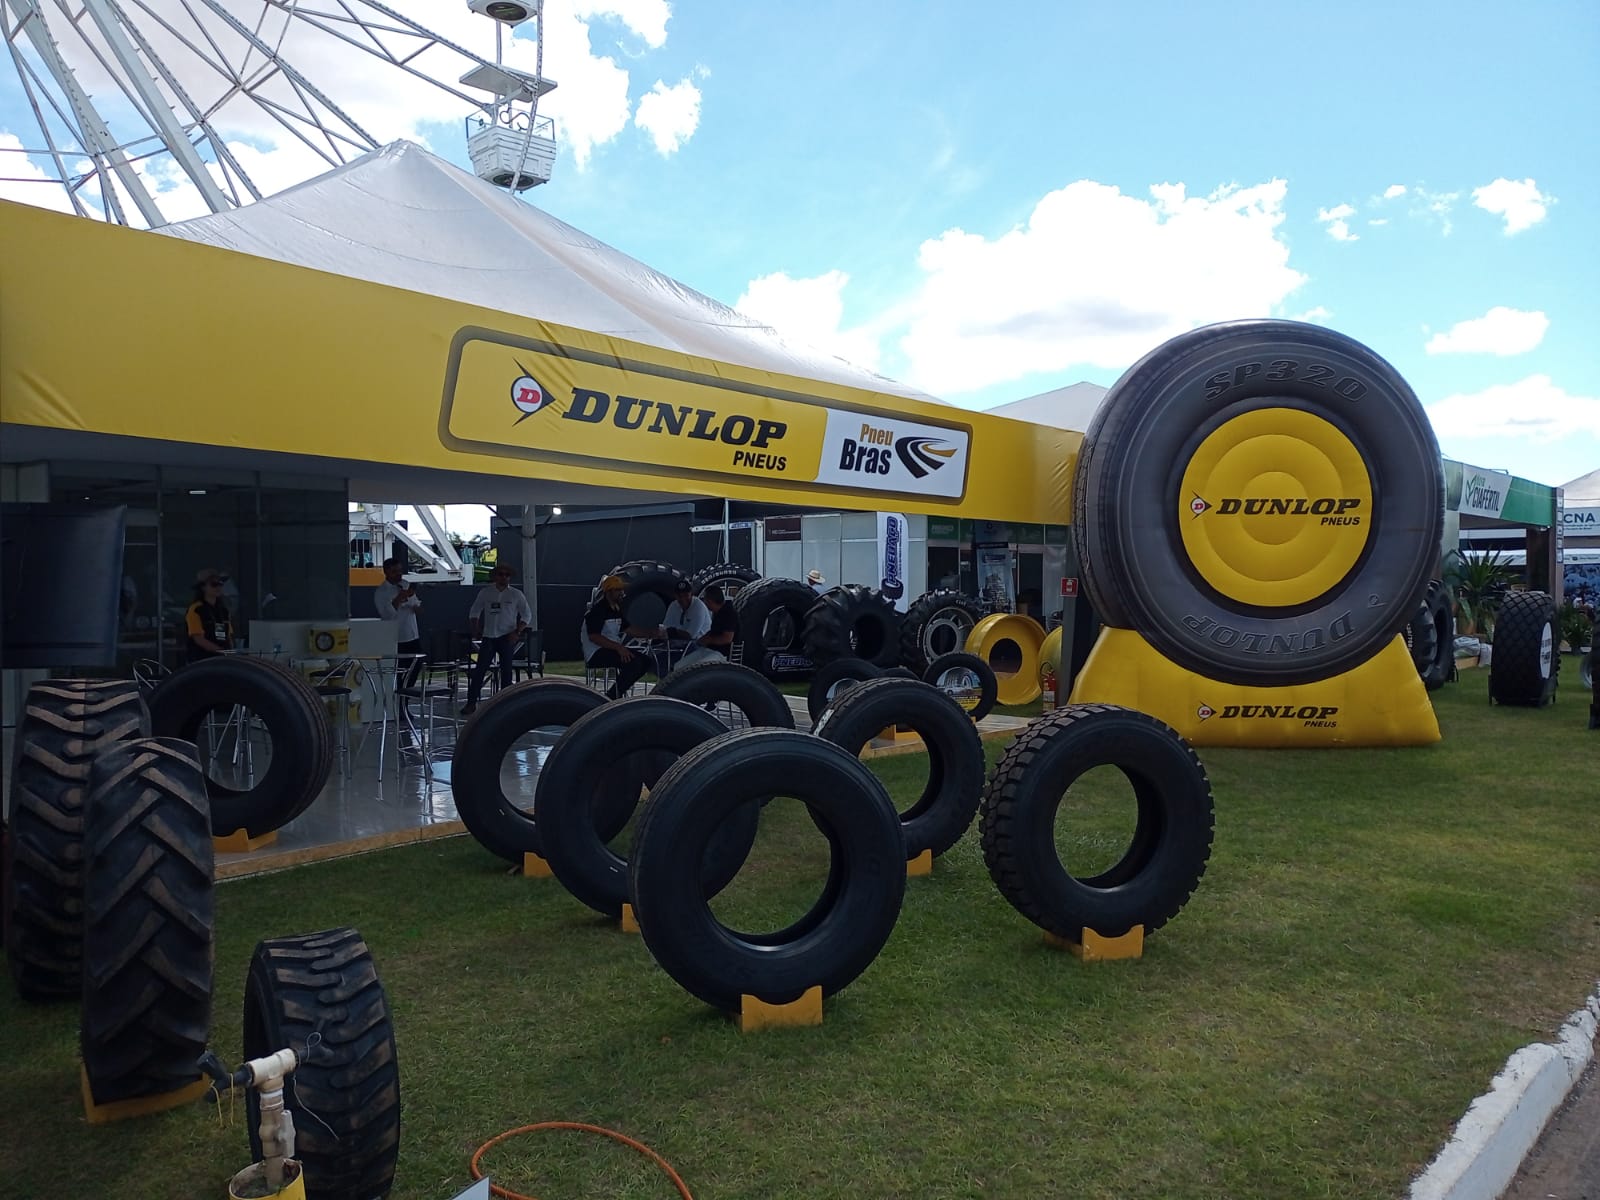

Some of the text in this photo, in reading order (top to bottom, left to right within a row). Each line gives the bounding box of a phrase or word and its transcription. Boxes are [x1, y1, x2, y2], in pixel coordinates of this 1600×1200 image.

[562, 386, 788, 449] DUNLOP
[859, 423, 894, 446] Pneu
[732, 450, 788, 472] PNEUS
[839, 438, 893, 476] Bras
[1216, 498, 1361, 515] DUNLOP
[1320, 516, 1361, 526] PNEUS
[1563, 512, 1596, 524] CNA
[1181, 610, 1355, 655] DUNLOP
[1220, 705, 1338, 719] DUNLOP
[1304, 720, 1337, 728] PNEUS
